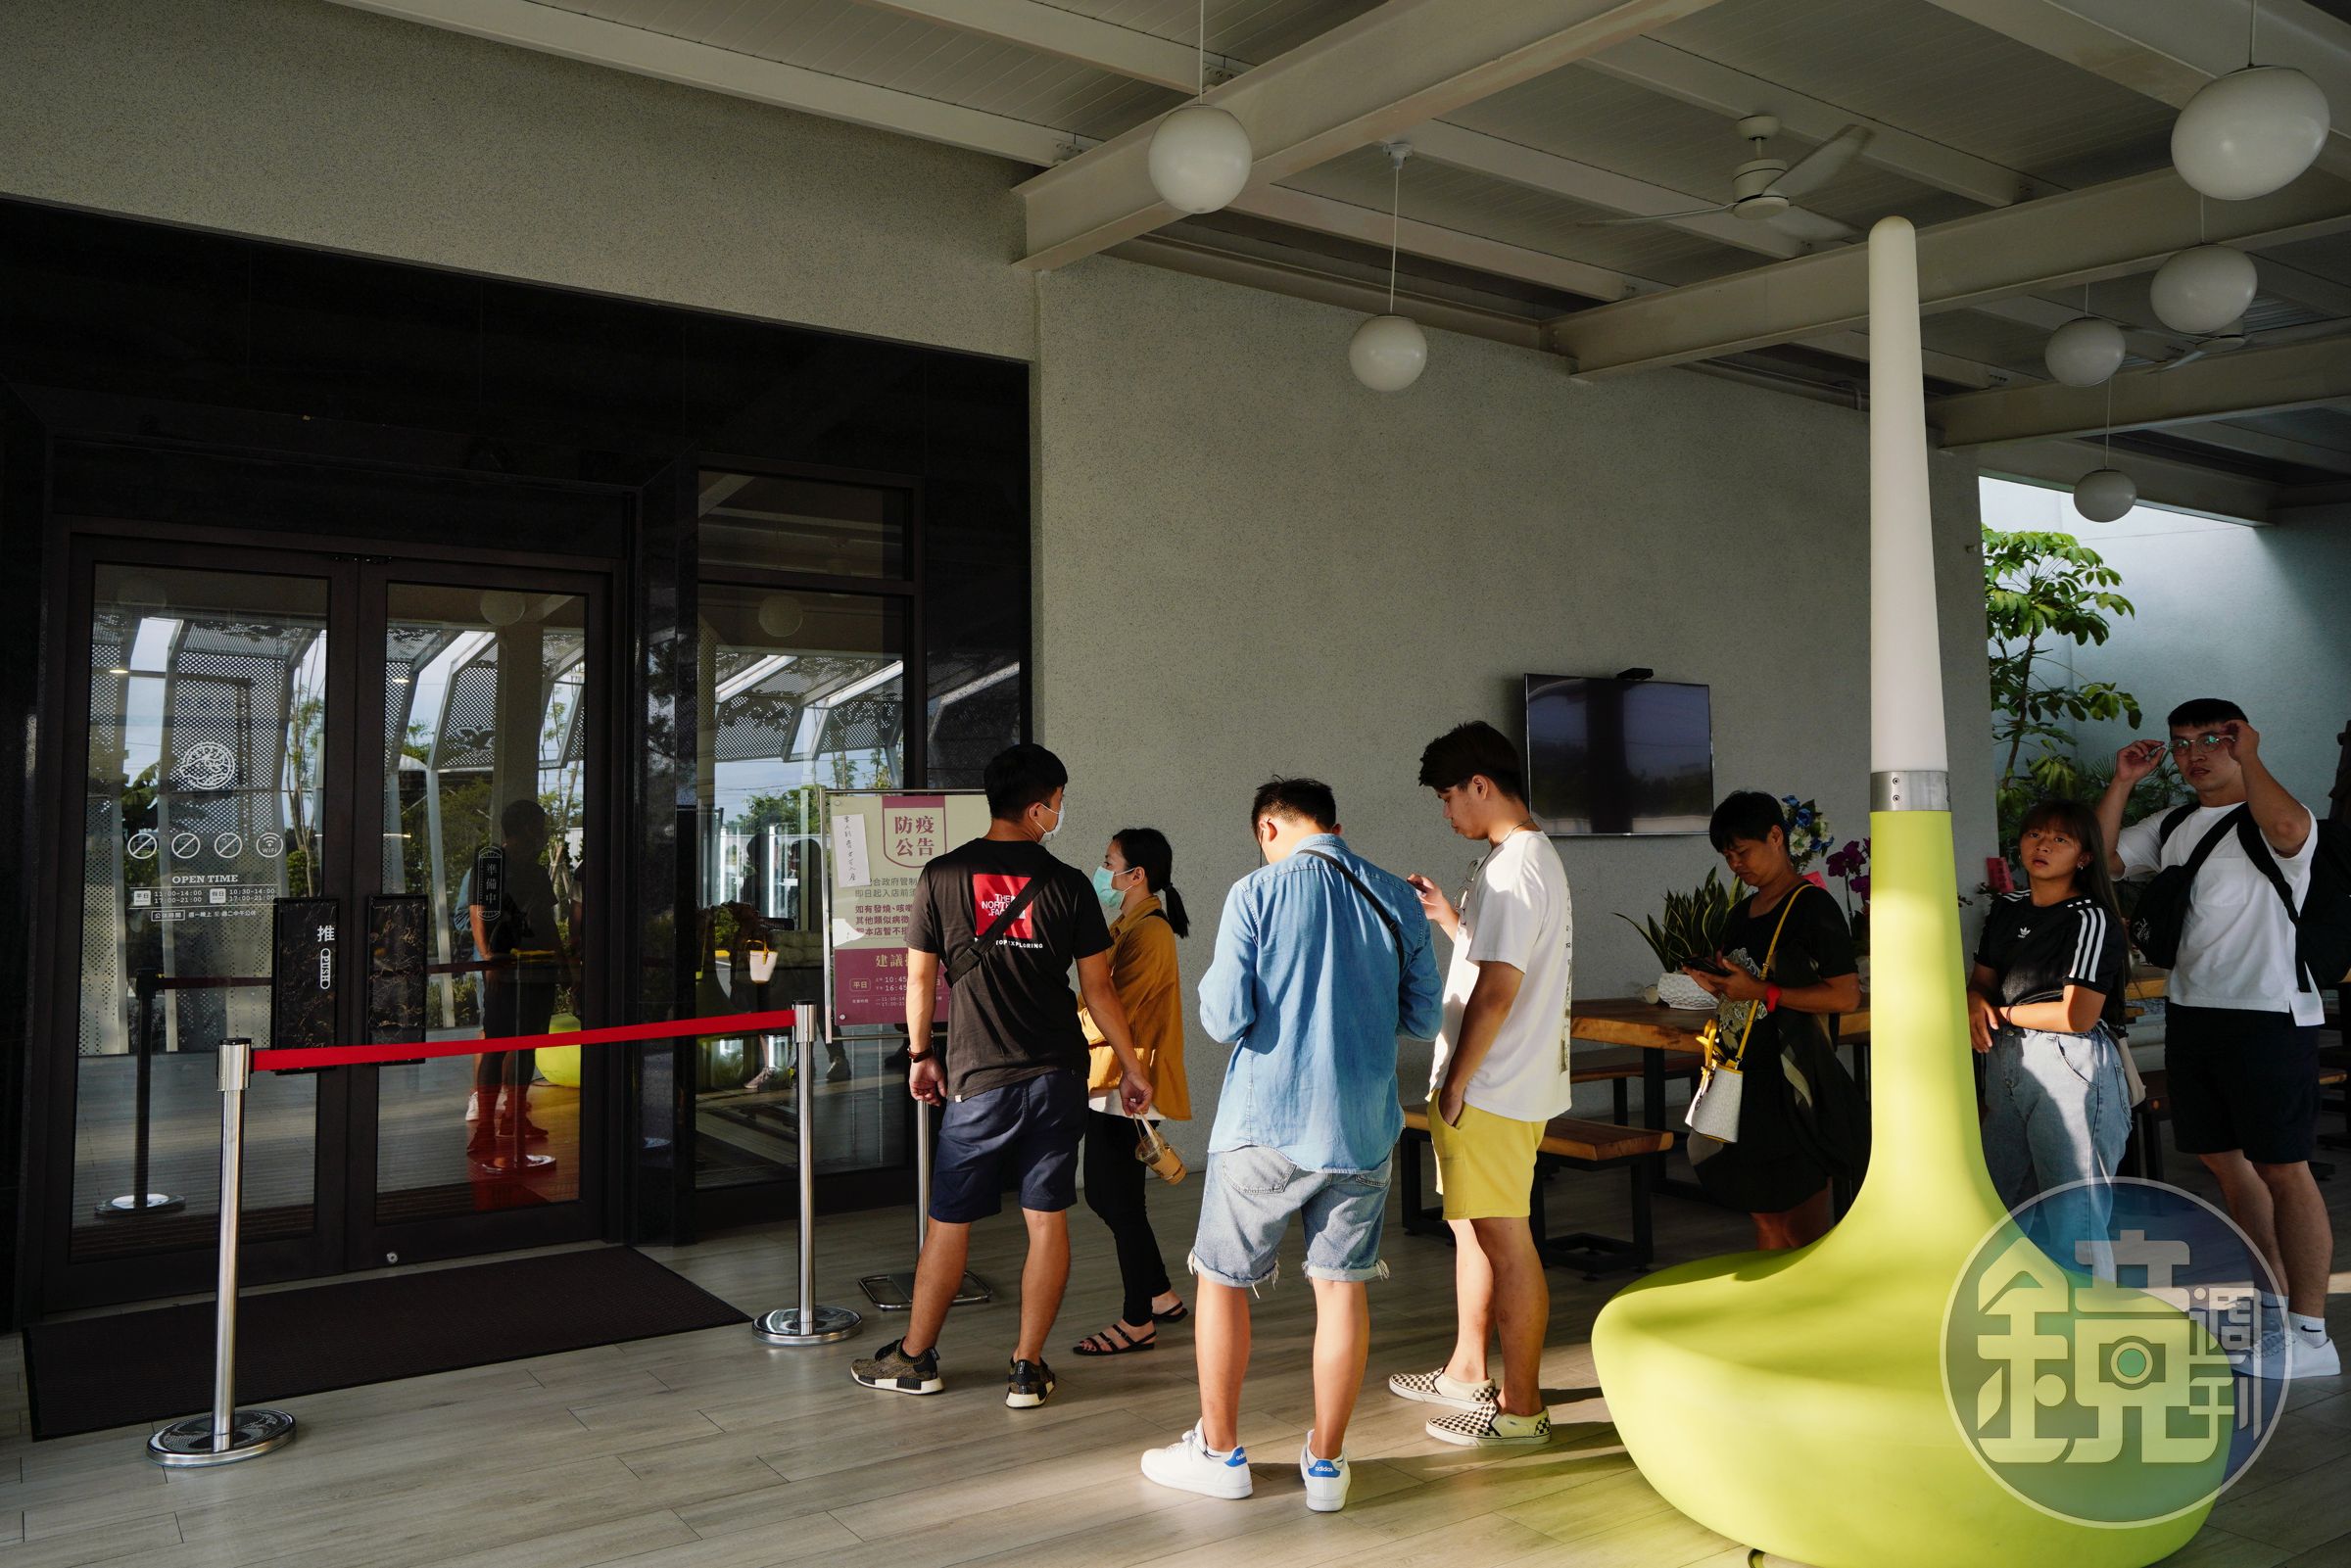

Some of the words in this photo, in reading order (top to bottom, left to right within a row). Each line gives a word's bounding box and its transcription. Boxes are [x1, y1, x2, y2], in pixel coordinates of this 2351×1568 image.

[894, 815, 935, 834] 防疫
[895, 837, 935, 857] 公告
[171, 875, 206, 884] OPEN
[208, 874, 239, 883] TIME
[994, 893, 1011, 903] THE
[316, 925, 335, 942] 推
[321, 955, 331, 982] PUSH
[876, 953, 909, 968] 建議
[852, 980, 868, 989] 平日
